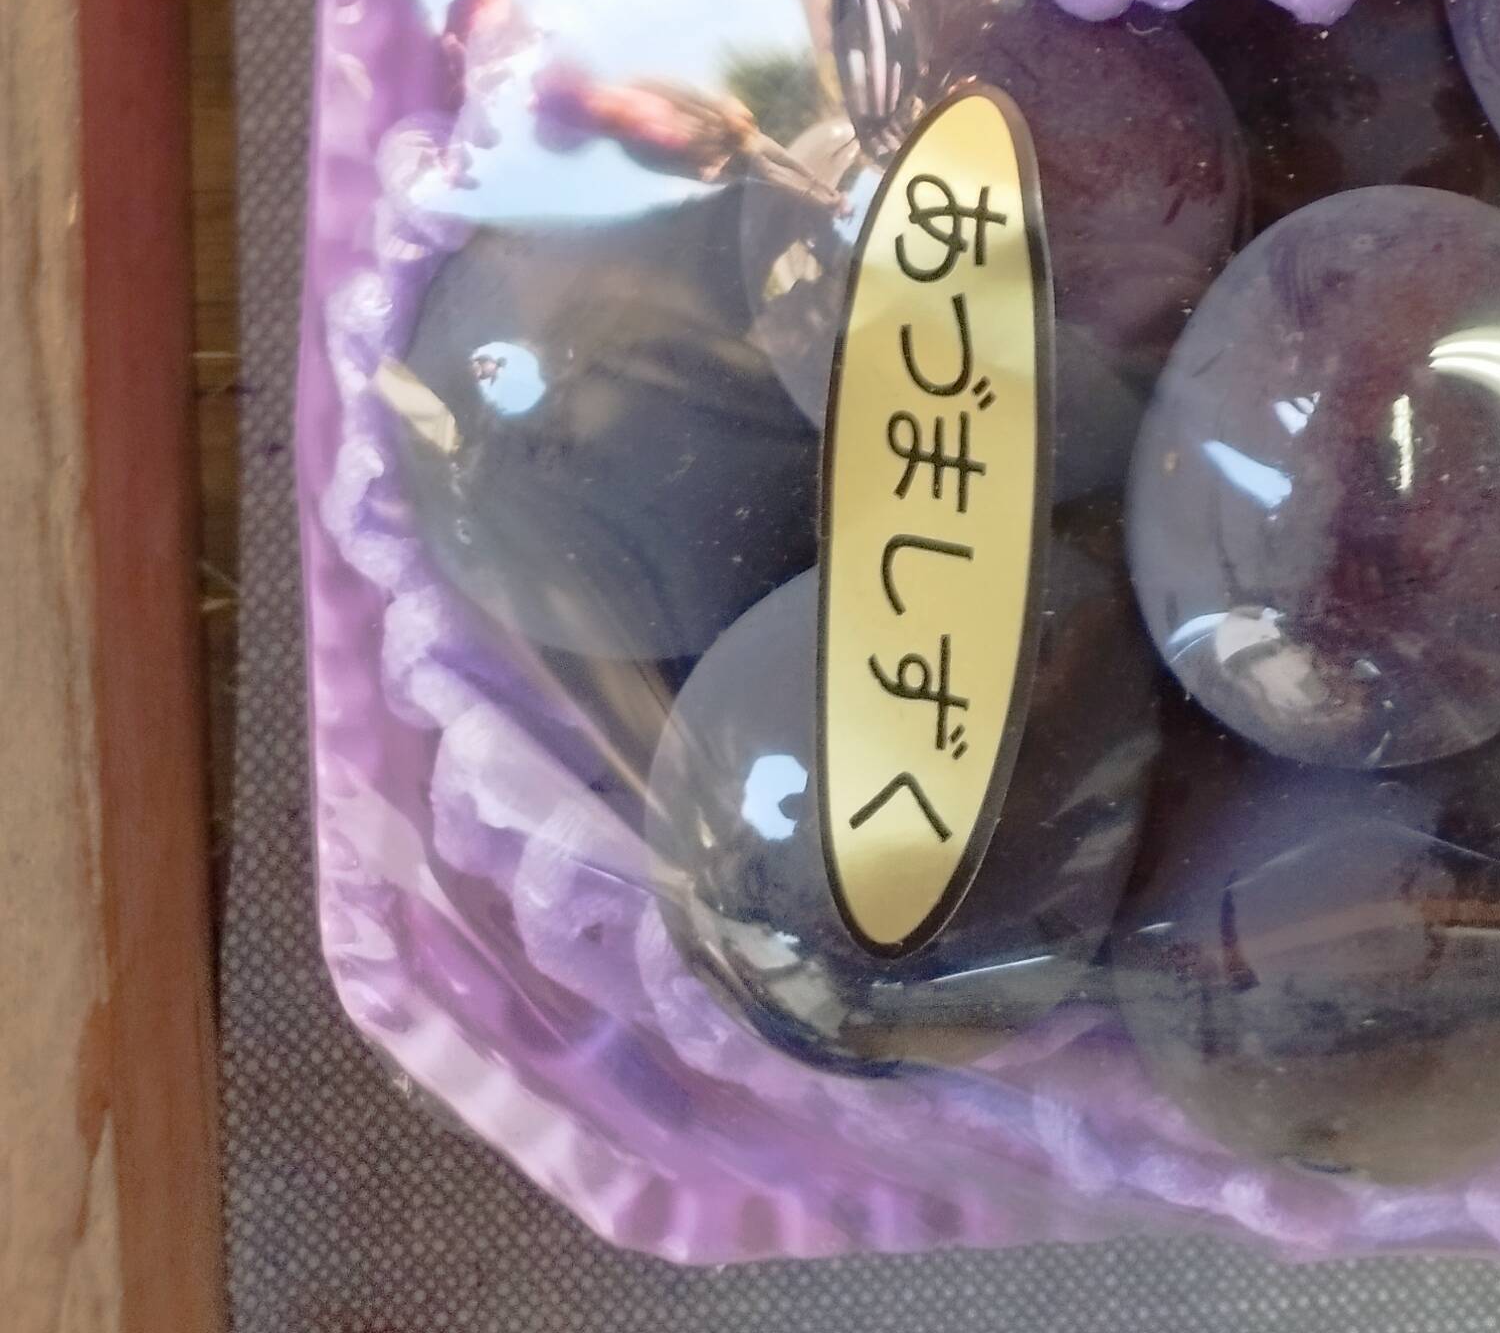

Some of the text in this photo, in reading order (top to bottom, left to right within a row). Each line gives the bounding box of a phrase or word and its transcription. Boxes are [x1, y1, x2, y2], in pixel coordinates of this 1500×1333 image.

[849, 172, 1007, 842] あづましずく
